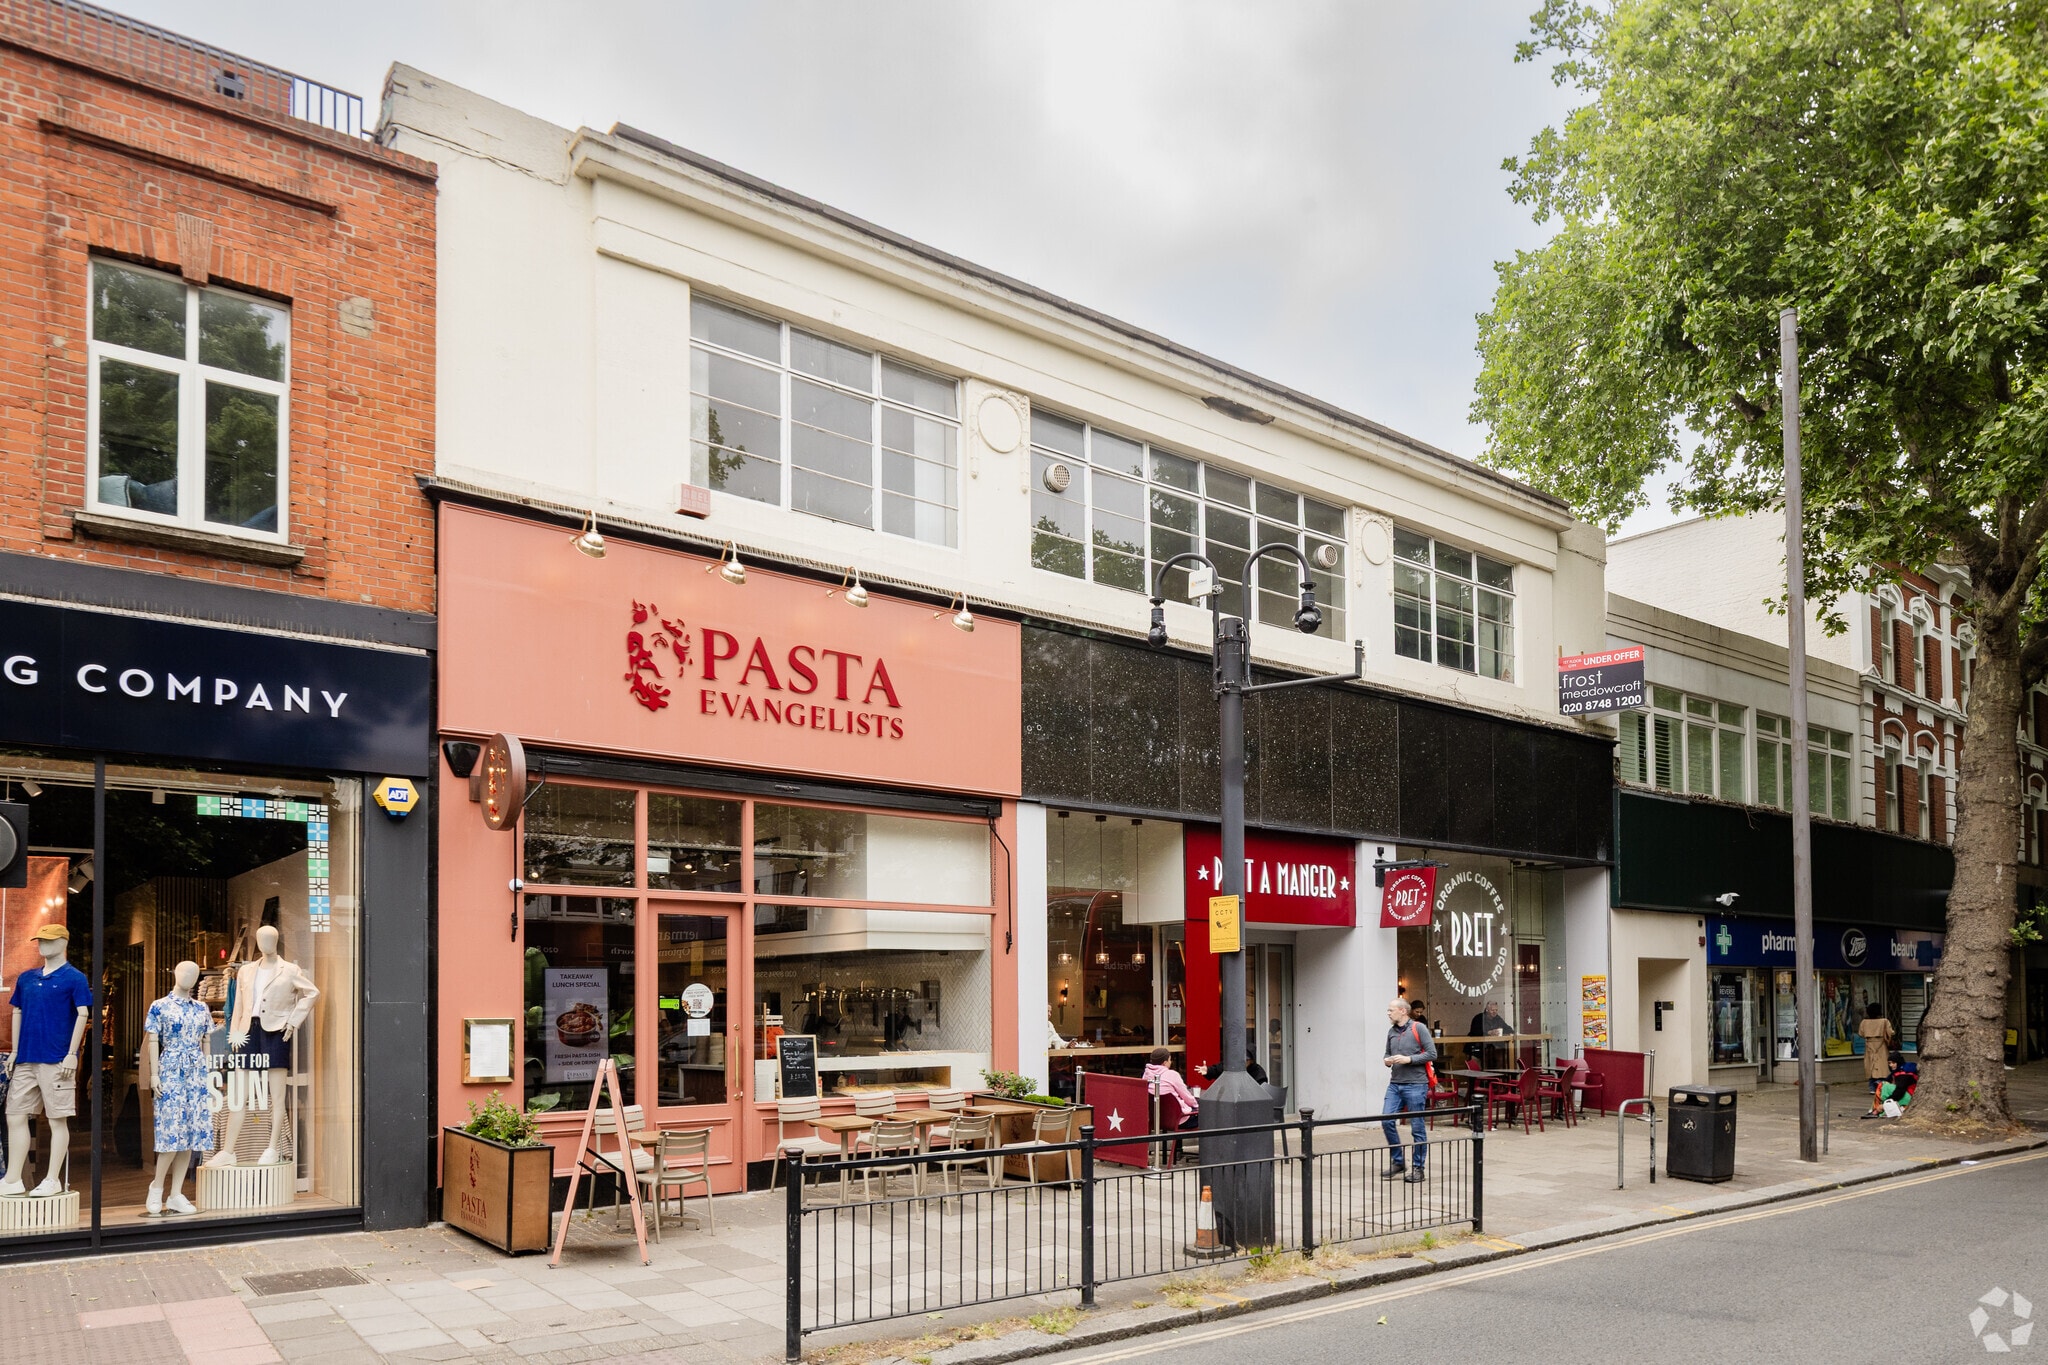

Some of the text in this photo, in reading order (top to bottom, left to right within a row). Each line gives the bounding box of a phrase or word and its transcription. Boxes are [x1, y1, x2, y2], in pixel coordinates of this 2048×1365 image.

[701, 627, 903, 709] PASTA
[1583, 654, 1613, 666] UNDER
[1613, 650, 1640, 661] OFFER
[76, 663, 348, 718] COMPANY
[1562, 670, 1603, 689] frost
[1562, 680, 1641, 700] meadowcroft
[700, 689, 904, 740] EVANGELISTS
[1562, 694, 1642, 713] 020 8748 1200
[389, 789, 408, 801] ADT
[1213, 856, 1337, 898] PT A MANGER
[1390, 874, 1427, 892] ORGANIC COFFEE
[1395, 888, 1420, 907] PRET
[1436, 871, 1505, 914] ORGANIC COFFEE
[1402, 913, 1417, 921] MADE
[1416, 900, 1426, 914] FOOD
[1450, 911, 1494, 957] PRET
[1890, 938, 1918, 960] beauty
[1434, 944, 1508, 997] FRESHLY MADE FOOD
[206, 1053, 270, 1069] GET SET FOR
[206, 1070, 269, 1113] SUN
[461, 1191, 487, 1219] PASTA
